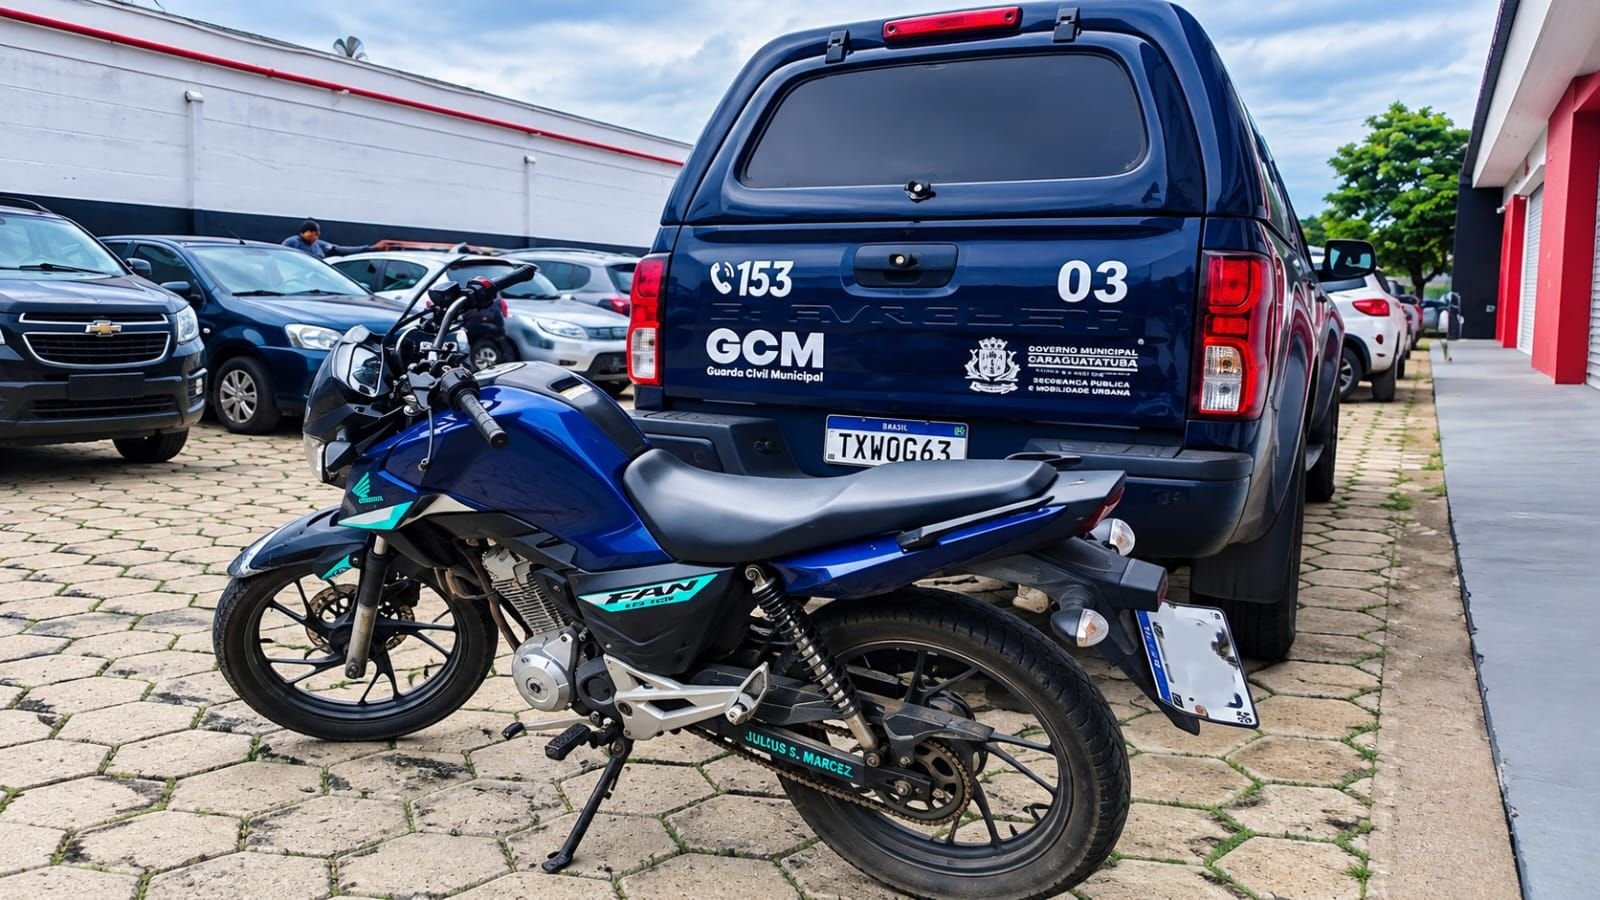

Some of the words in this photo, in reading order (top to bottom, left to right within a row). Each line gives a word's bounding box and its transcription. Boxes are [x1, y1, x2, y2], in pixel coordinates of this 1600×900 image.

[736, 260, 794, 298] 153
[1057, 259, 1128, 304] 03
[706, 328, 824, 368] GCM
[1028, 355, 1138, 367] CARAGUATATUBA
[1080, 347, 1138, 356] MUNICIPAL
[707, 366, 744, 377] Guarda
[770, 370, 824, 383] Municipal
[605, 579, 699, 605] FAN
[788, 746, 801, 760] S.
[803, 751, 854, 778] MARCEZ
